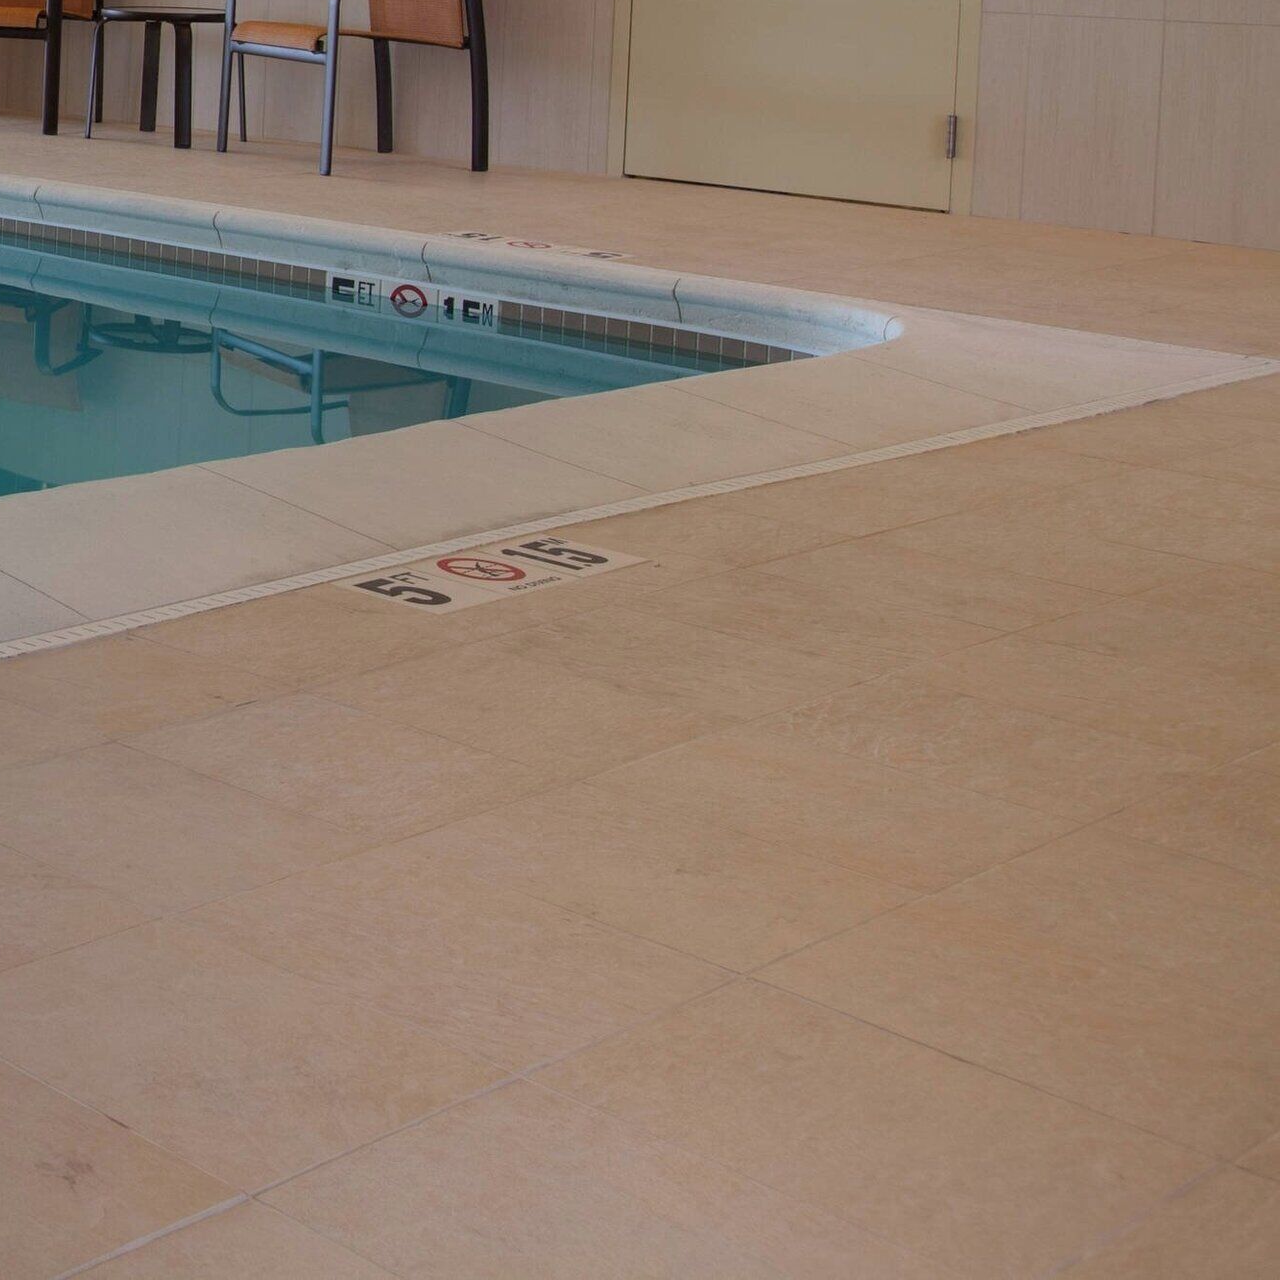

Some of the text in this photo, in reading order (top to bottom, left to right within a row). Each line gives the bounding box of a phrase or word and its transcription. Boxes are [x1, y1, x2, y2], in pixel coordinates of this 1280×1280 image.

[501, 541, 609, 570] 1.5
[352, 572, 452, 605] 5 FT
